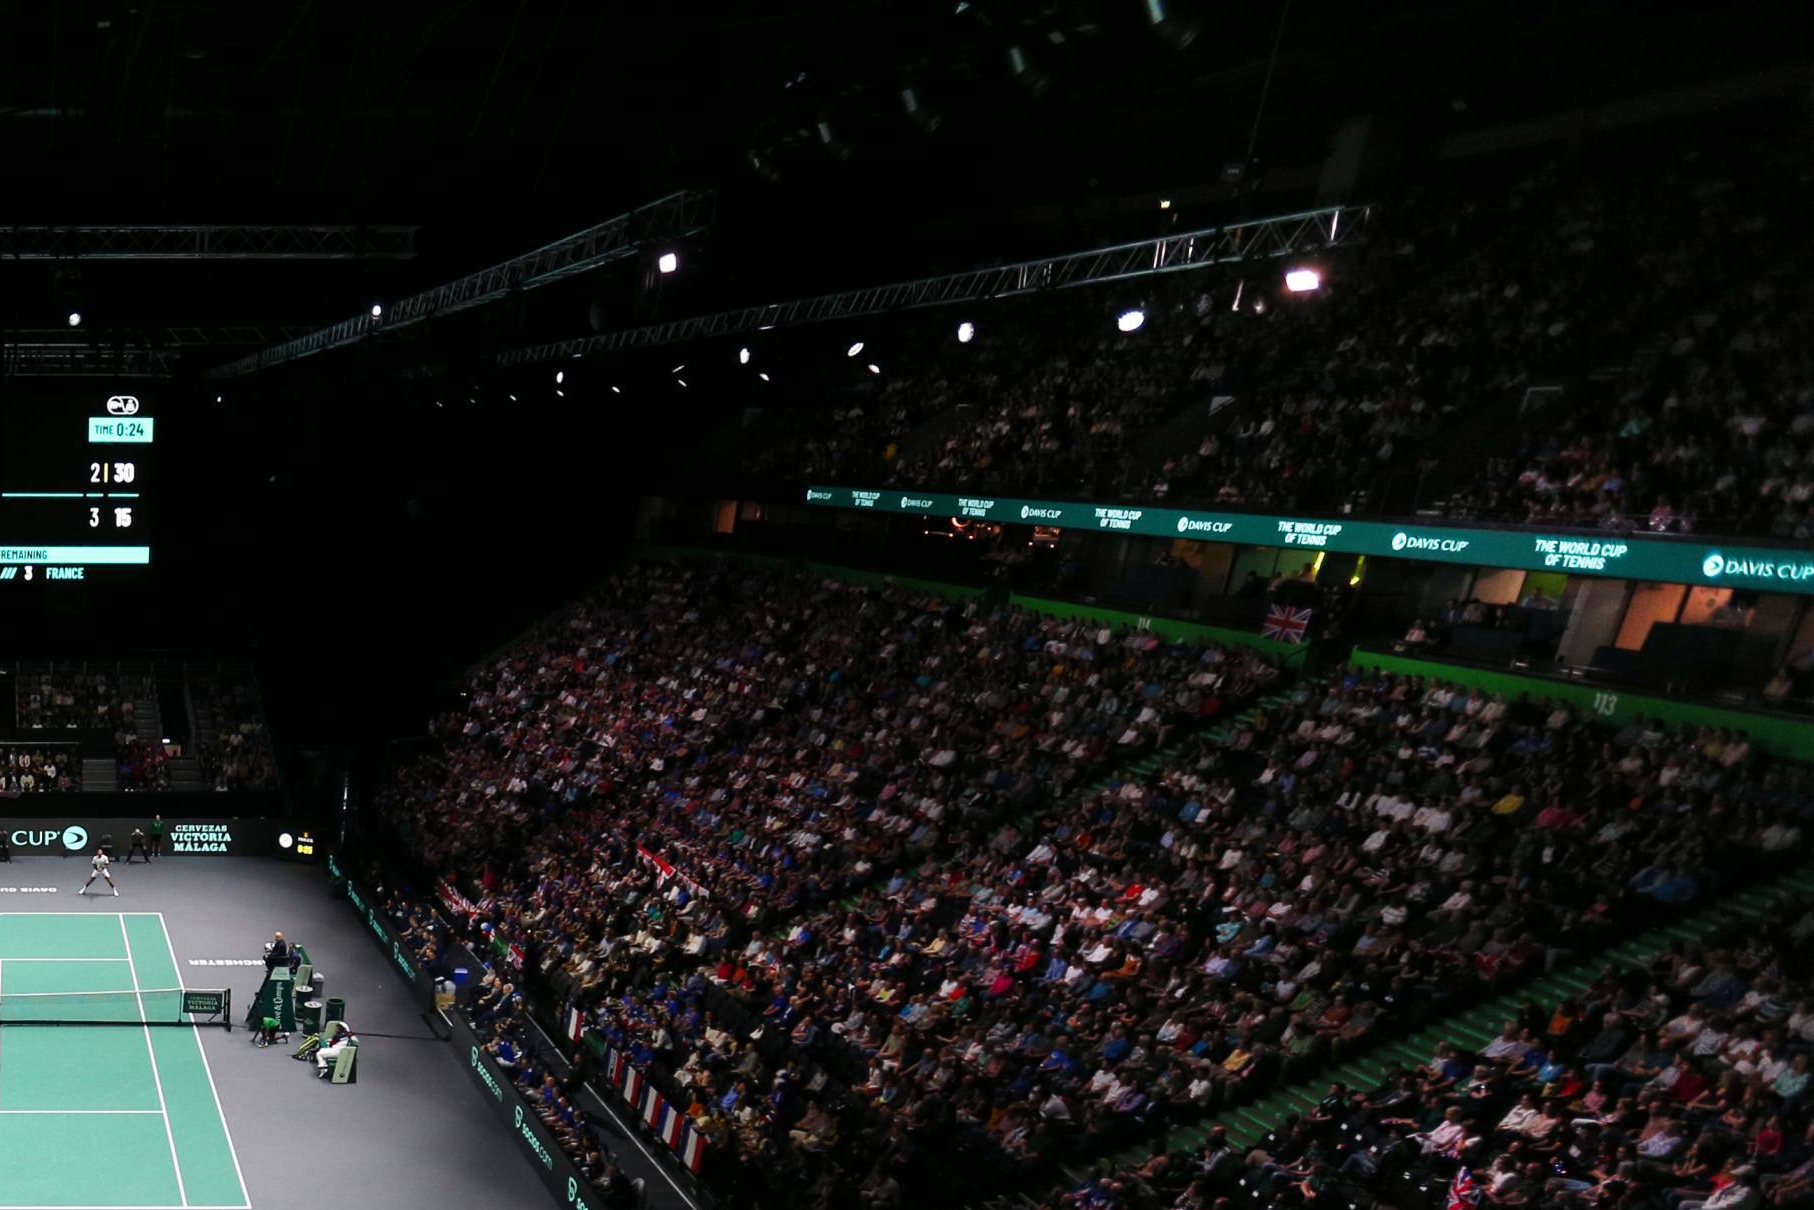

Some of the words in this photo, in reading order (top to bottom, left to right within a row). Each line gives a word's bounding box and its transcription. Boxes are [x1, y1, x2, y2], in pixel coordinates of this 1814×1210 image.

[95, 424, 114, 435] TIME
[116, 422, 144, 437] 0:24
[90, 462, 101, 483] 2
[114, 462, 135, 483] 30
[89, 507, 99, 527] 3
[114, 507, 132, 527] 15
[1188, 520, 1212, 531] DAVIS
[1213, 522, 1233, 533] CUP
[1278, 521, 1295, 532] THE
[1294, 522, 1324, 534] WORLD
[1323, 524, 1342, 535] CUP
[1285, 532, 1298, 543] OF
[1406, 537, 1441, 550] DAVIS
[1441, 539, 1470, 552] CUP
[0, 549, 48, 561] REMAINING
[1535, 539, 1559, 552] THE
[1559, 541, 1601, 556] WORLD
[1600, 543, 1628, 558] CUP
[1544, 553, 1563, 566] OF
[1562, 555, 1606, 570] TENNIS
[24, 566, 33, 580] 3
[46, 567, 84, 579] FRANCE
[1725, 560, 1775, 577] DAVIS
[1777, 564, 1814, 580] CUP
[175, 824, 228, 833] CERVEZAS
[10, 831, 62, 847] CUP
[169, 832, 233, 842] VICTORIA
[173, 841, 229, 852] MÁLAGA
[521, 1121, 553, 1171] socios.com
